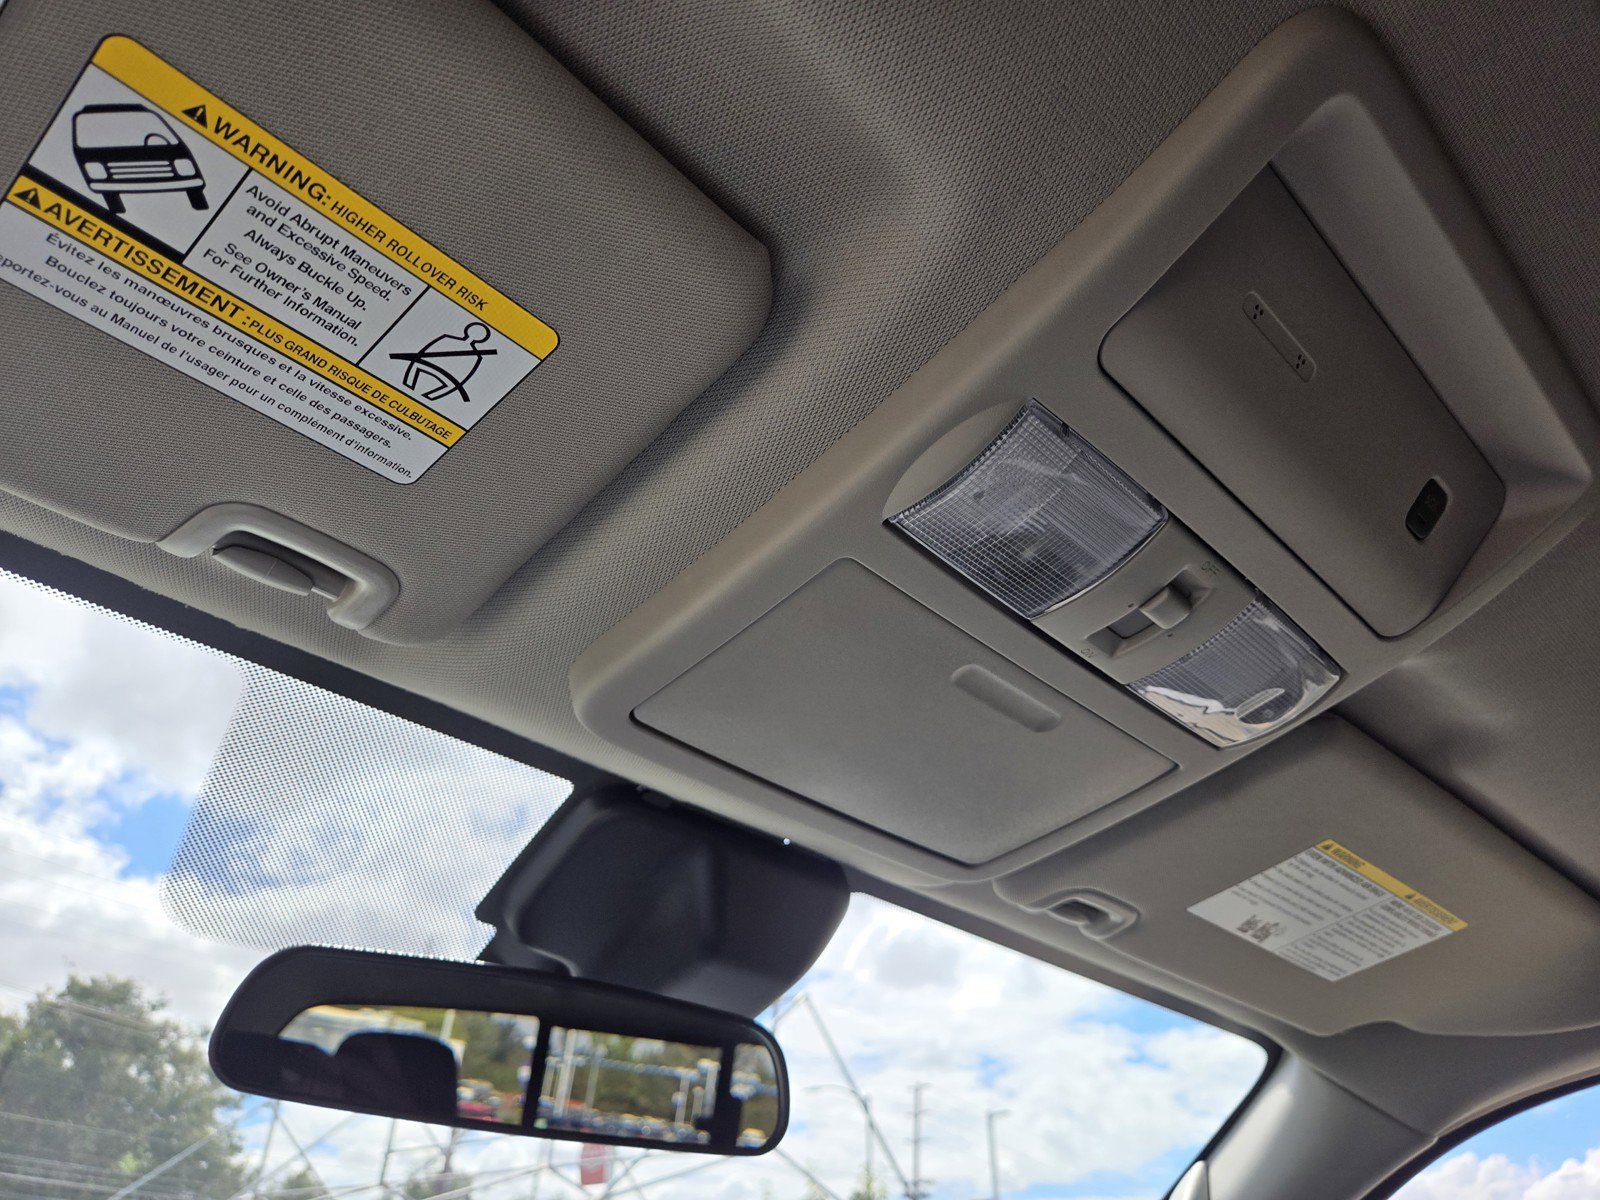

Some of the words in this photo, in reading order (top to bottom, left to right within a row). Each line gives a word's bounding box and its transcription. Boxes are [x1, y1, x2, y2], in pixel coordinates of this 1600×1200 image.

[214, 116, 331, 206] WARNING:
[330, 200, 387, 243] HIGHER
[385, 238, 457, 290] ROLLOVER
[455, 285, 488, 311] RISK
[245, 185, 291, 217] Avoid
[289, 213, 340, 250] Abrupt
[339, 244, 412, 296] Maneuvers
[246, 205, 278, 228] and
[276, 222, 346, 272] Excessive
[347, 267, 392, 302] Speed.
[202, 247, 230, 268] For
[229, 263, 283, 300] Further
[282, 295, 358, 347] Information.
[224, 242, 253, 266] See
[254, 261, 312, 301] Owner's
[312, 295, 362, 330] Manual
[243, 229, 297, 266] Always
[296, 260, 345, 295] Buckle
[346, 290, 367, 312] Up.
[45, 232, 96, 266] Évitez
[97, 261, 121, 280] les
[123, 277, 210, 329] manœuvres
[211, 324, 277, 365] brusques
[278, 363, 293, 374] et
[293, 369, 307, 382] la
[309, 378, 352, 407] vitesse
[354, 404, 412, 441] excessive.
[45, 255, 107, 295] Bouclez
[109, 290, 169, 327] toujours
[171, 324, 206, 348] votre
[208, 345, 261, 377] ceinture
[262, 375, 277, 386] et
[278, 383, 308, 402] celle
[308, 399, 332, 415] des
[330, 412, 391, 449] passagers.
[90, 305, 109, 318] au
[110, 313, 161, 344] Manuel
[160, 342, 178, 354] de
[179, 349, 231, 381] l'usager
[228, 378, 260, 396] pour
[259, 393, 276, 406] un
[277, 403, 346, 442] complément
[344, 438, 412, 479] d'information.
[248, 319, 284, 344] PLUS
[284, 340, 328, 369] GRAND
[327, 364, 373, 394] RISQUE
[370, 389, 390, 404] DE
[388, 400, 452, 440] CULBUTAGE
[1201, 561, 1220, 575] OFF
